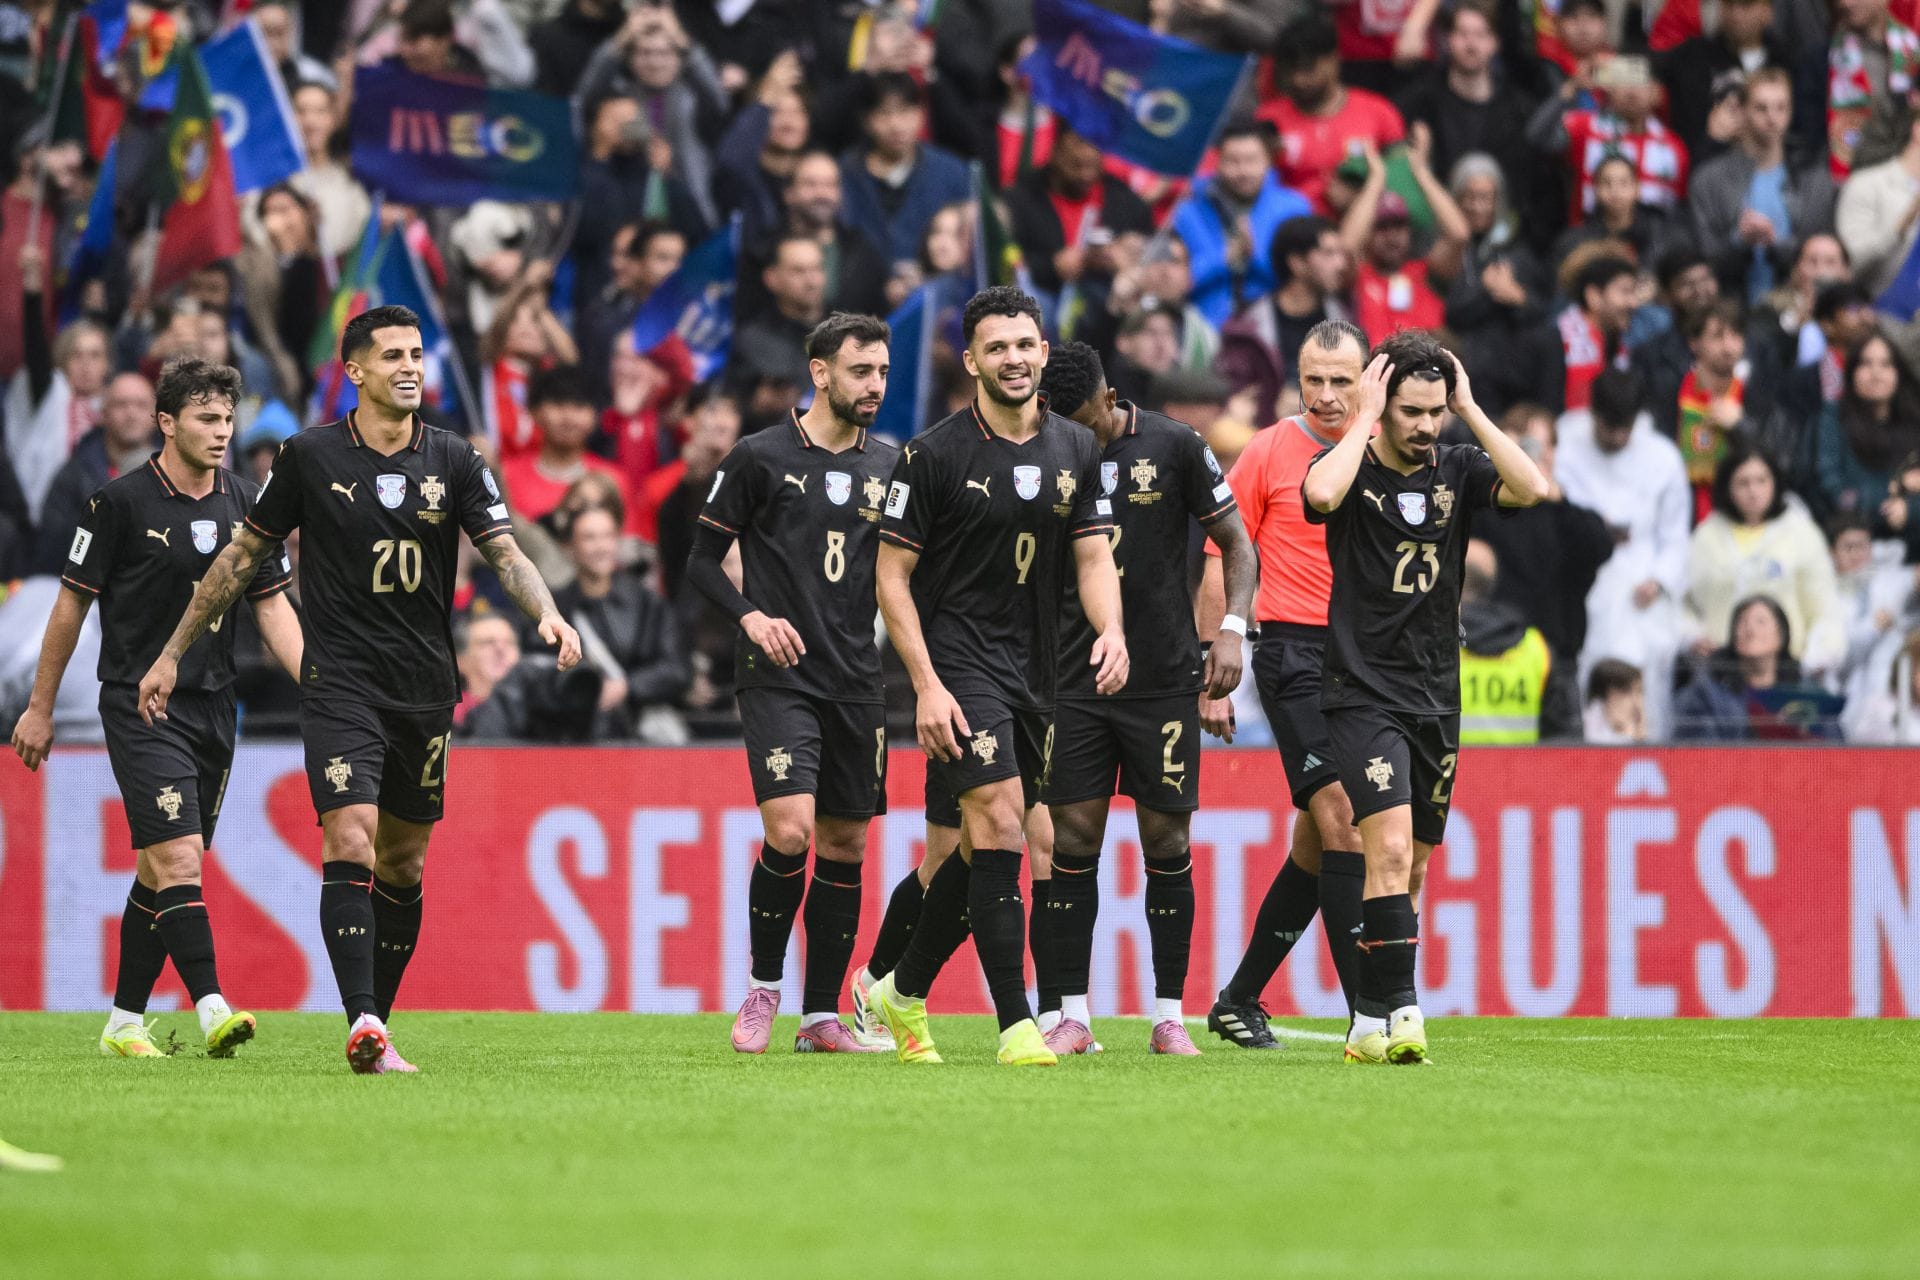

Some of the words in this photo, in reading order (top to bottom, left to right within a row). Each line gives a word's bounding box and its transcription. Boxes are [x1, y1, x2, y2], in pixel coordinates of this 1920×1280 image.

[372, 539, 422, 593] 20
[824, 530, 846, 583] 8
[1015, 532, 1036, 585] 9
[1392, 540, 1440, 594] 23
[1467, 675, 1528, 705] 104
[1161, 720, 1185, 773] 2
[1430, 752, 1458, 804] 2
